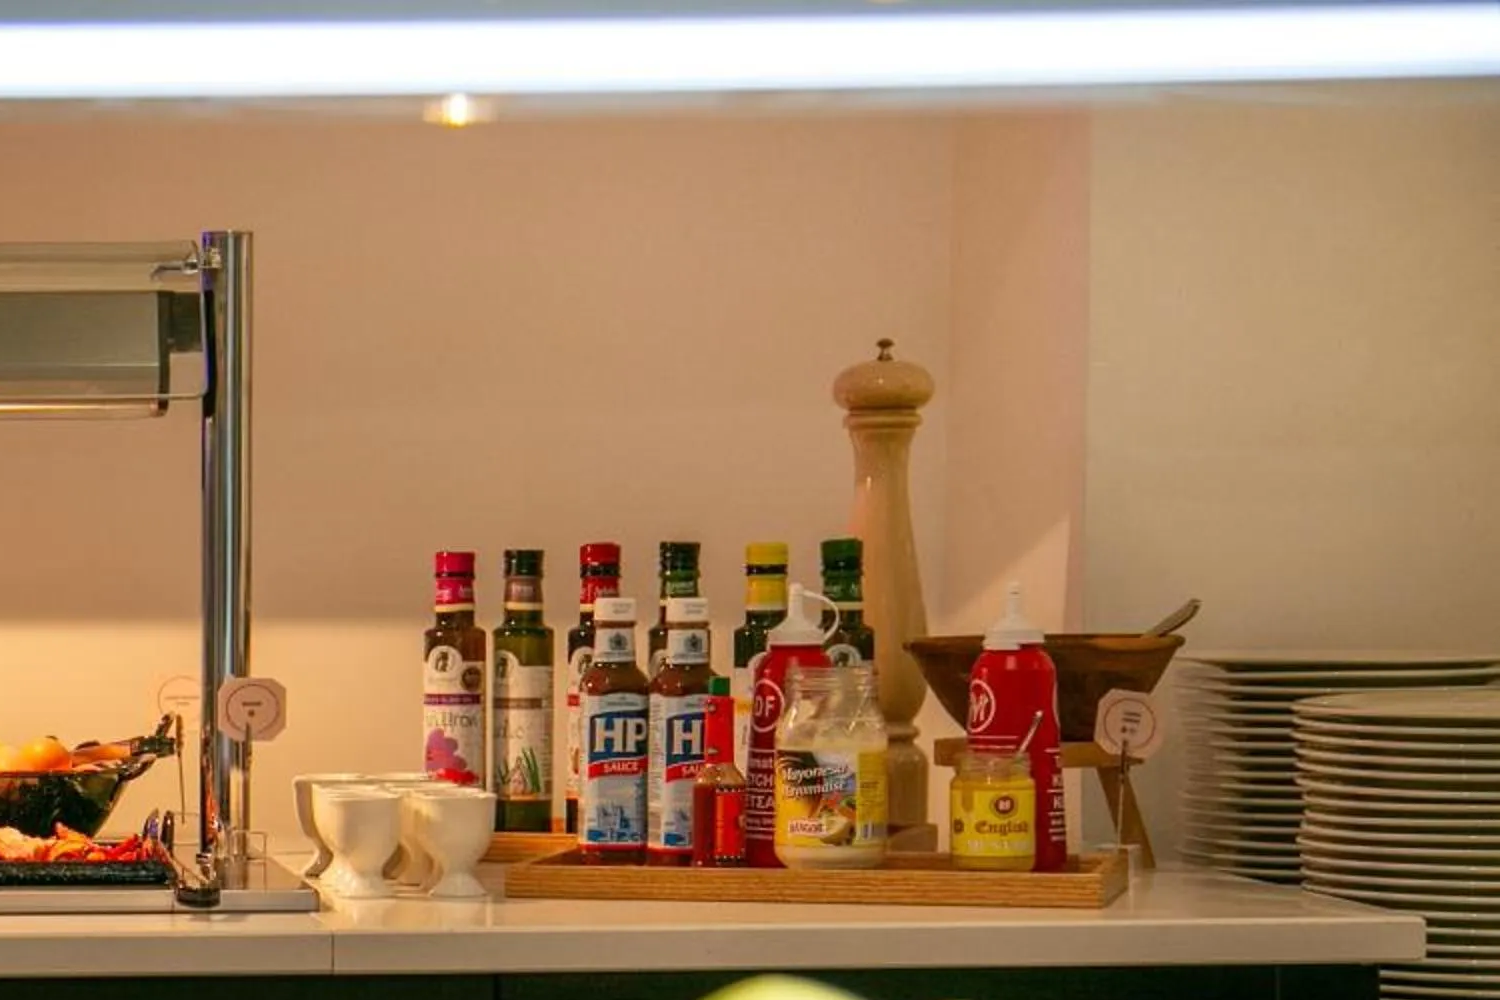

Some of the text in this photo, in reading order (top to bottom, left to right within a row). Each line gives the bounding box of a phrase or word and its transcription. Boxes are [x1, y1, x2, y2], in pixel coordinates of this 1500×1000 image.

[594, 716, 648, 753] HP
[672, 719, 704, 755] H
[603, 761, 640, 774] SAUCE
